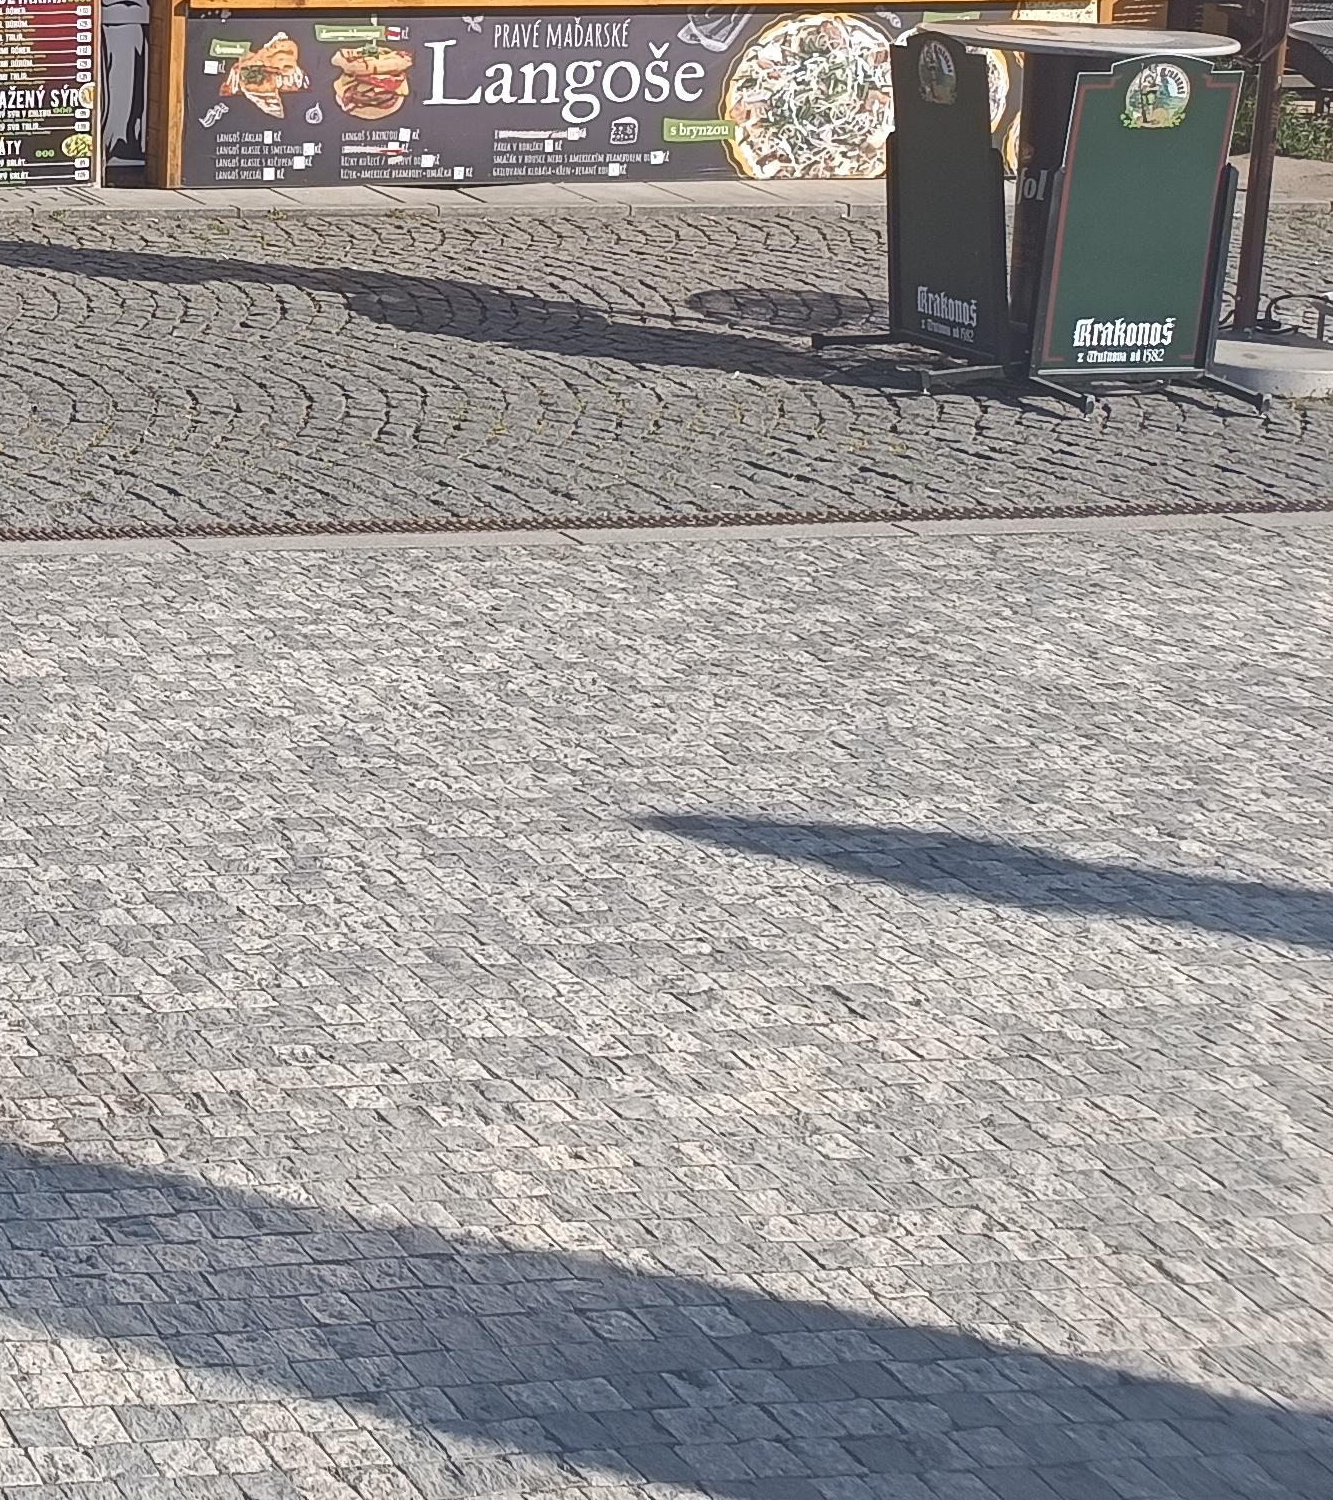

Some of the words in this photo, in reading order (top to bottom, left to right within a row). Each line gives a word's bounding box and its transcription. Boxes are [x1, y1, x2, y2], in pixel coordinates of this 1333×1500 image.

[493, 19, 541, 48] PRAVÉ
[546, 17, 632, 49] MAĎARSKÉ
[50, 84, 79, 108] SÝR
[422, 39, 706, 124] Langoše
[670, 126, 678, 136] s
[679, 123, 729, 139] brynzou
[917, 285, 978, 328] Krakonoš
[1073, 317, 1177, 348] Krakonoš
[1142, 348, 1166, 364] 1582
